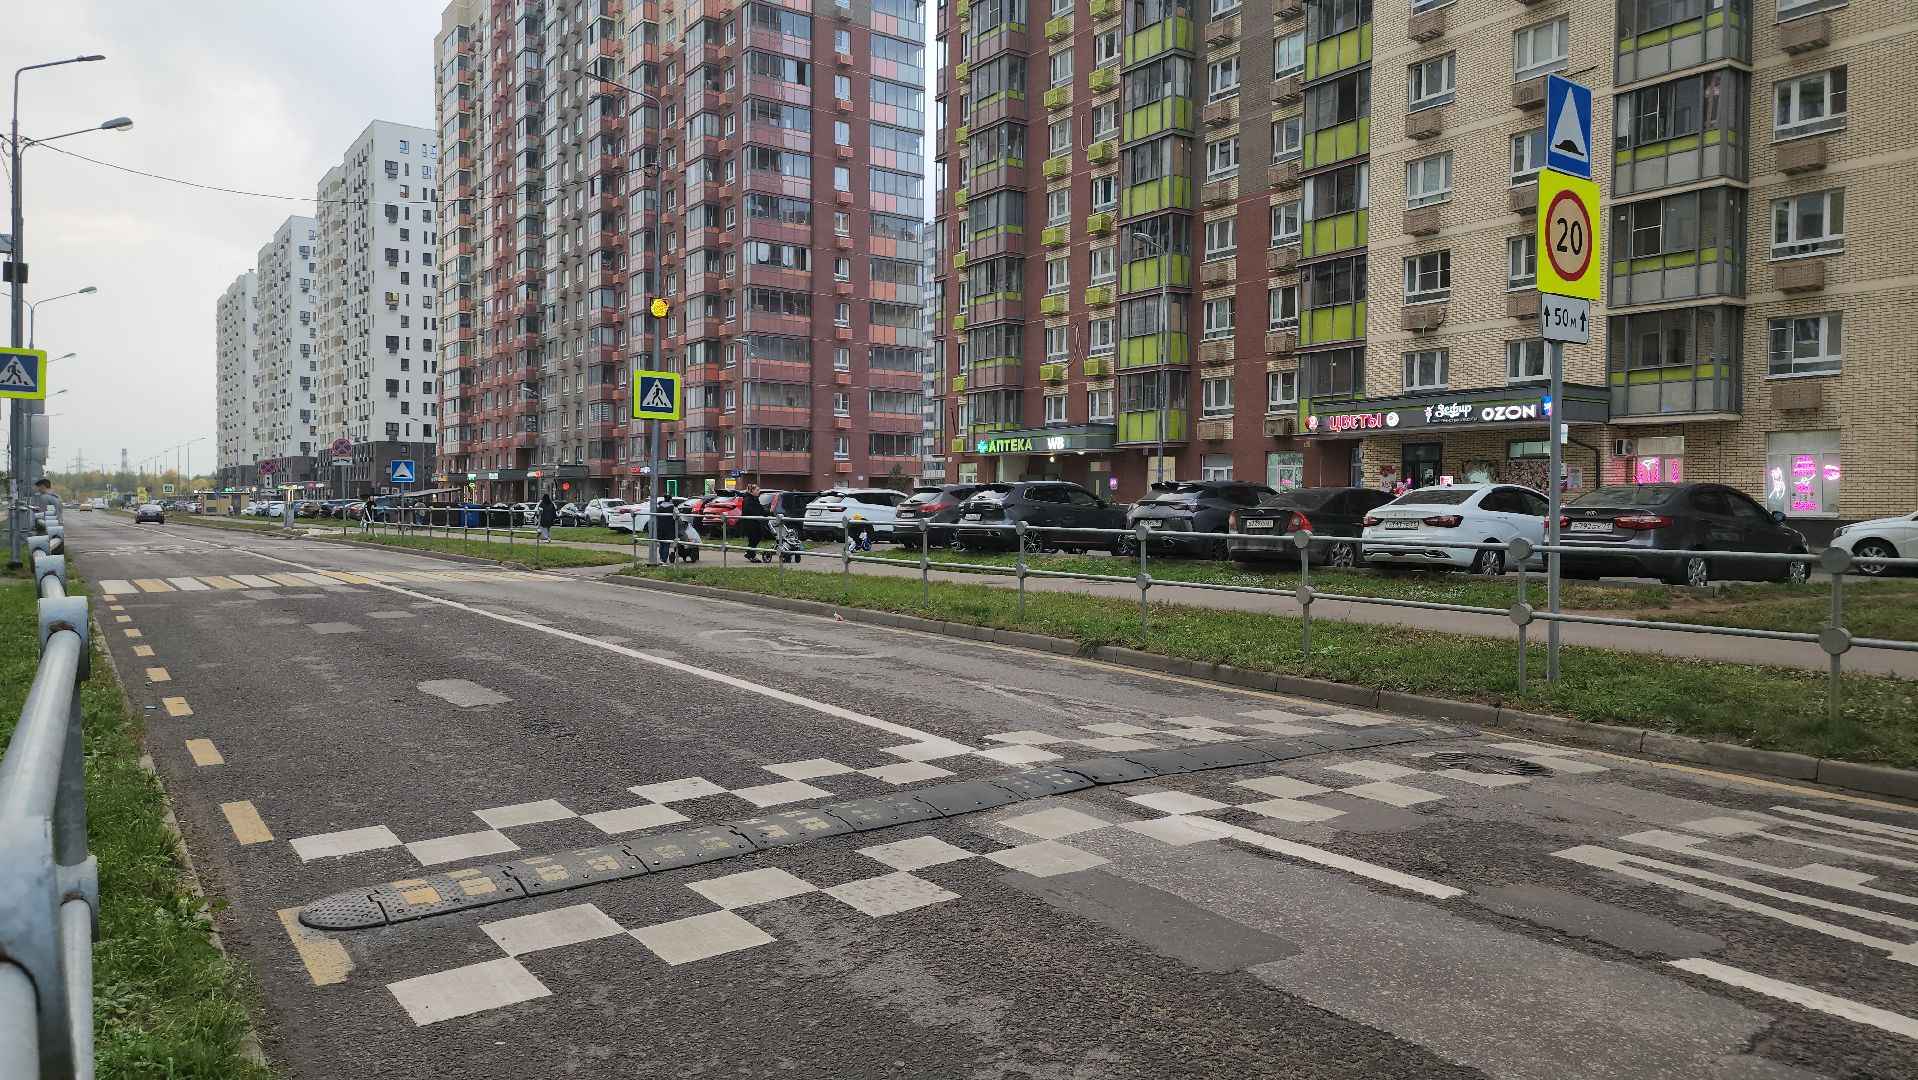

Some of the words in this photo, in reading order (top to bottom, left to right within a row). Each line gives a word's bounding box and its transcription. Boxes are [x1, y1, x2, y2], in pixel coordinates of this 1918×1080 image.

[1556, 217, 1583, 256] 20
[1481, 403, 1538, 421] OZON
[1329, 412, 1382, 432] ЦВЕТЫ
[988, 438, 1033, 453] АПТЕКА
[1046, 436, 1065, 450] WB
